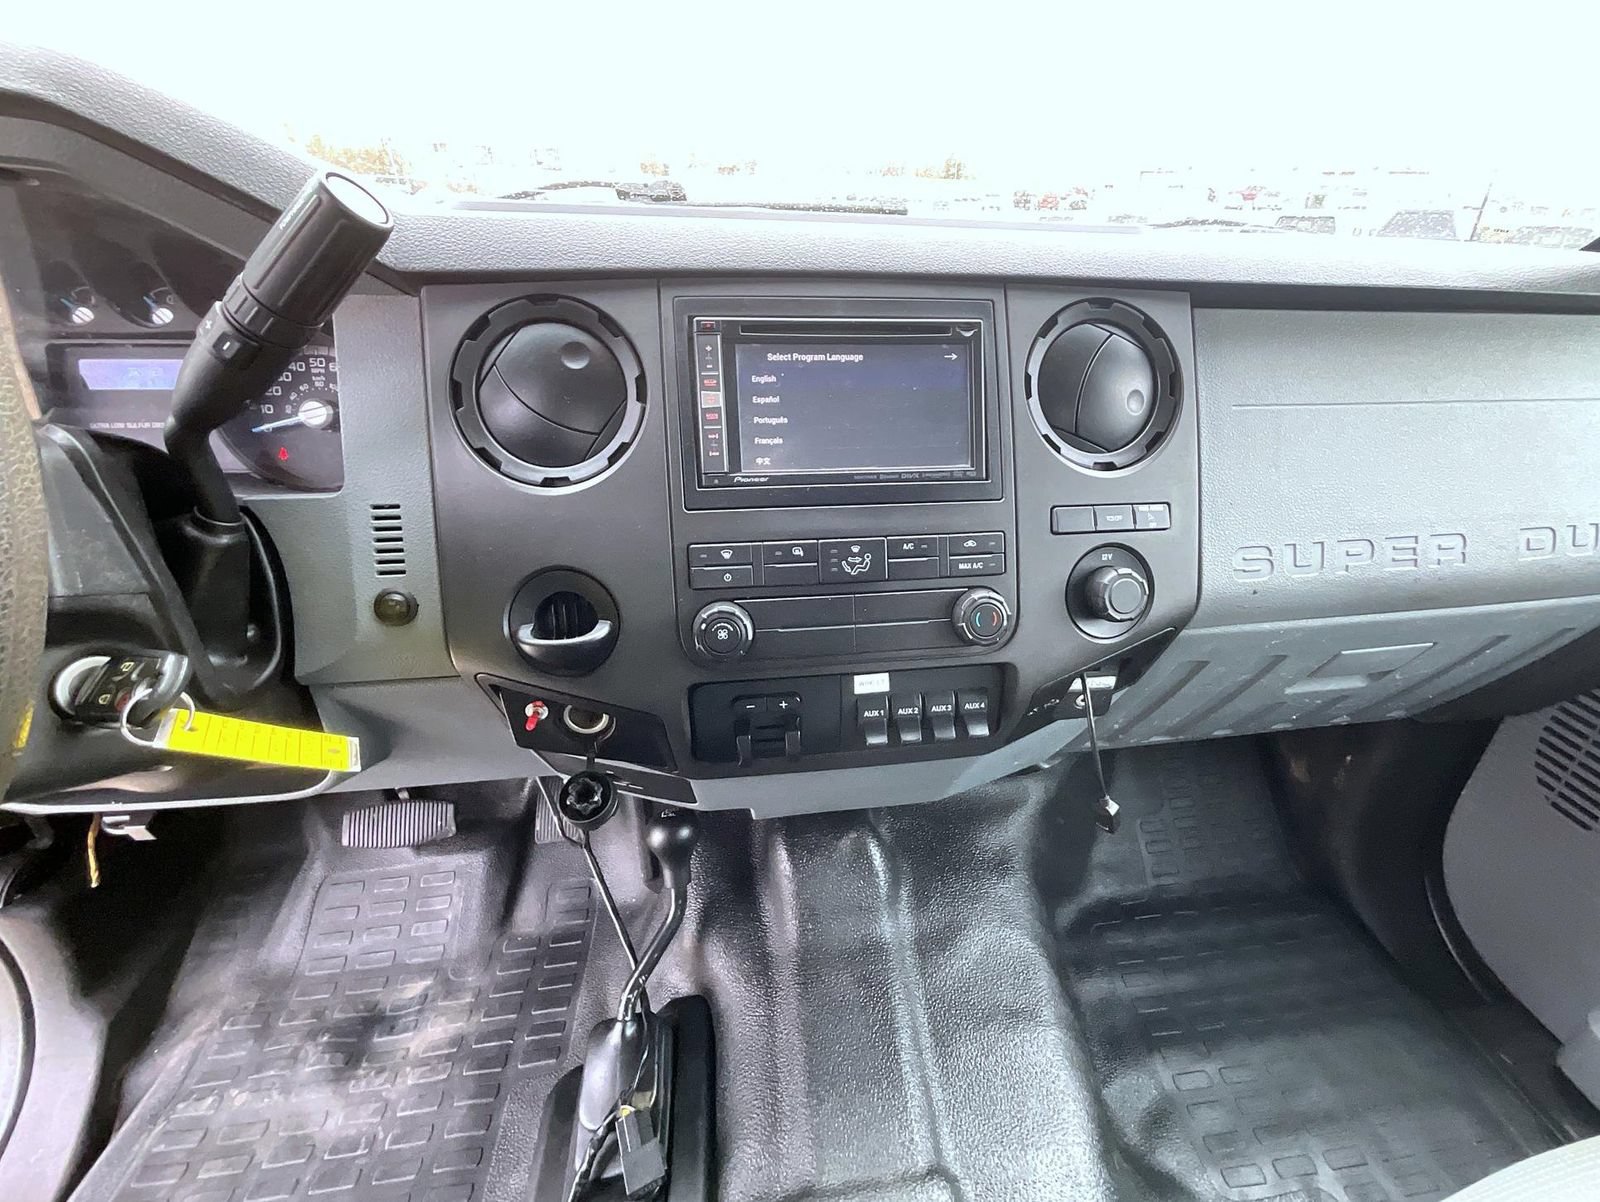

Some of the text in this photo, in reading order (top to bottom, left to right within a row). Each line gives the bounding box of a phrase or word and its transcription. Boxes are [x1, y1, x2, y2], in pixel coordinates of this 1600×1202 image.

[309, 357, 326, 367] 50
[767, 352, 864, 363] Select Program Language
[288, 361, 306, 371] 40
[751, 374, 777, 384] English
[752, 395, 780, 406] Español
[261, 404, 273, 414] 10
[753, 416, 789, 426] Português
[754, 436, 784, 447] Français
[733, 475, 770, 483] Pioneer
[902, 542, 914, 550] A/C
[1232, 531, 1469, 583] SUPER
[931, 705, 947, 713] AUX
[964, 702, 980, 710] AUX
[863, 710, 880, 718] AUX
[897, 707, 919, 716] AUX 2
